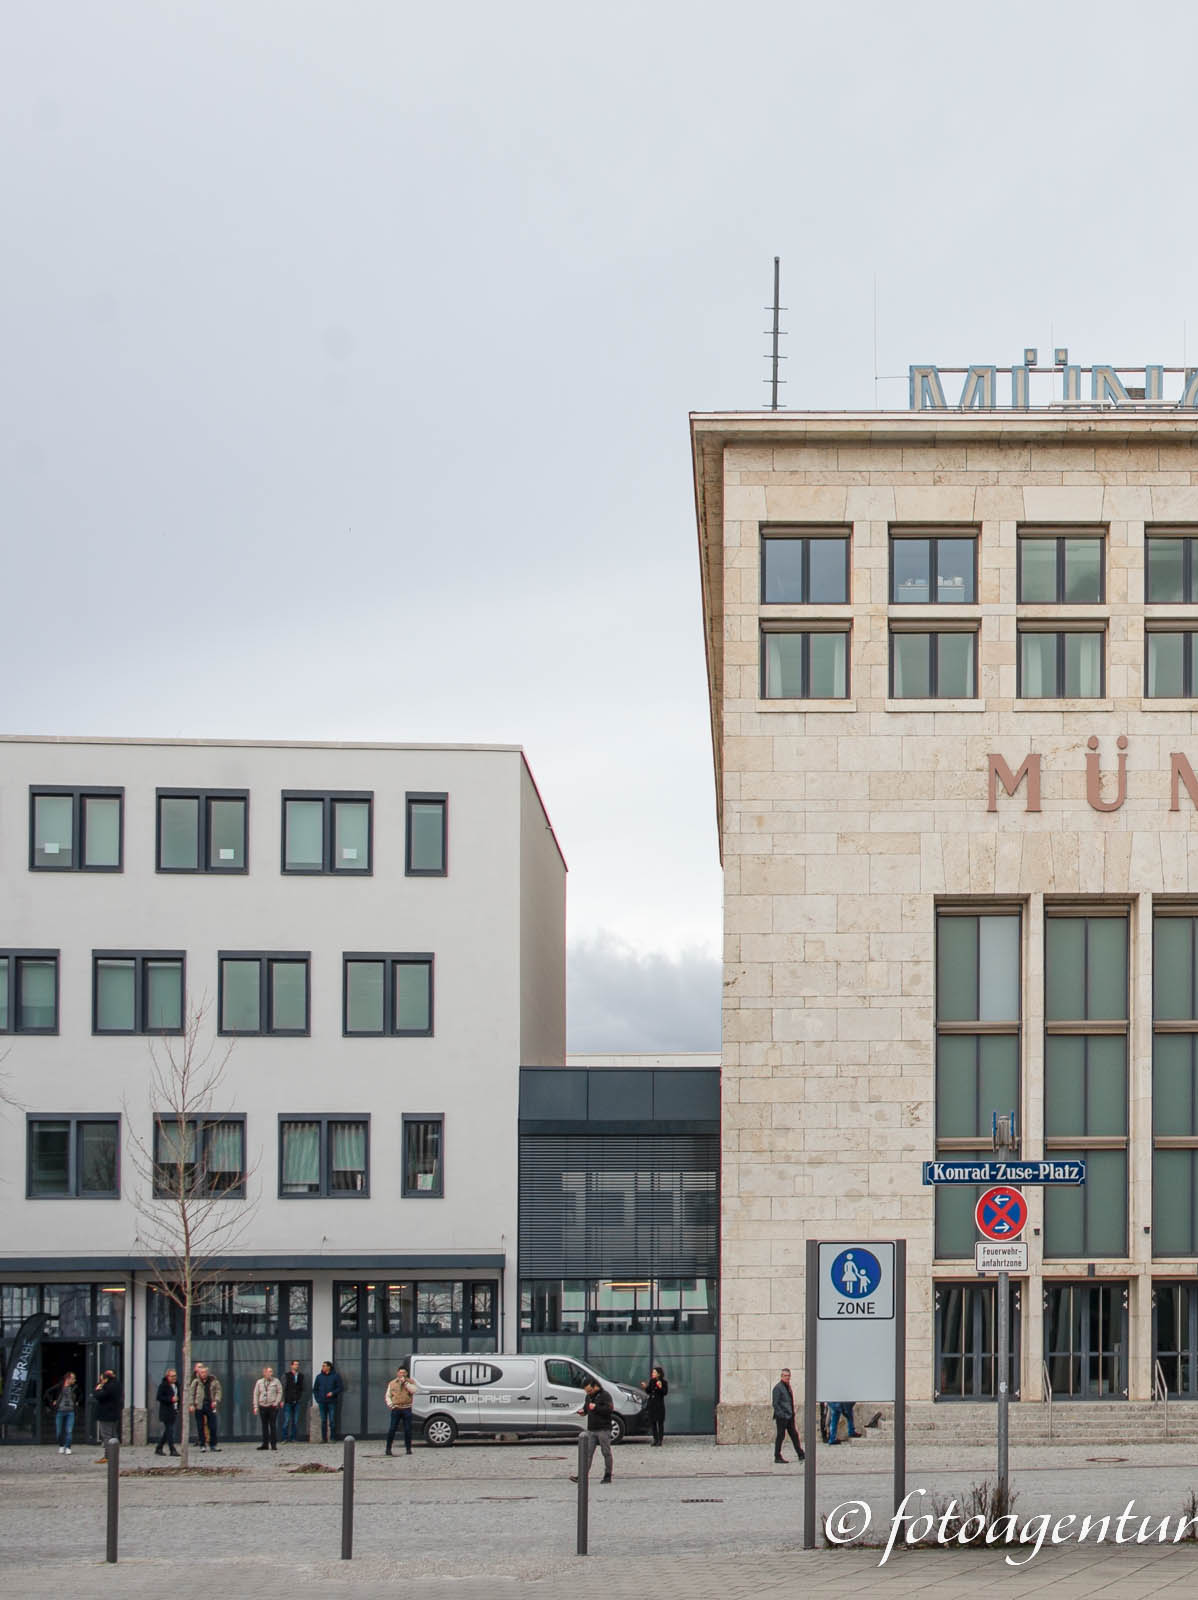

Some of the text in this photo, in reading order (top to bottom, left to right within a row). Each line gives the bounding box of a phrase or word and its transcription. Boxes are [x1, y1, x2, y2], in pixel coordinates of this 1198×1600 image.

[933, 1162, 1080, 1181] Konrad-Zuse-Platz
[982, 1246, 1022, 1256] Feuerwehr-
[981, 1259, 1022, 1267] anfahrtzone
[836, 1301, 876, 1315] ZONE
